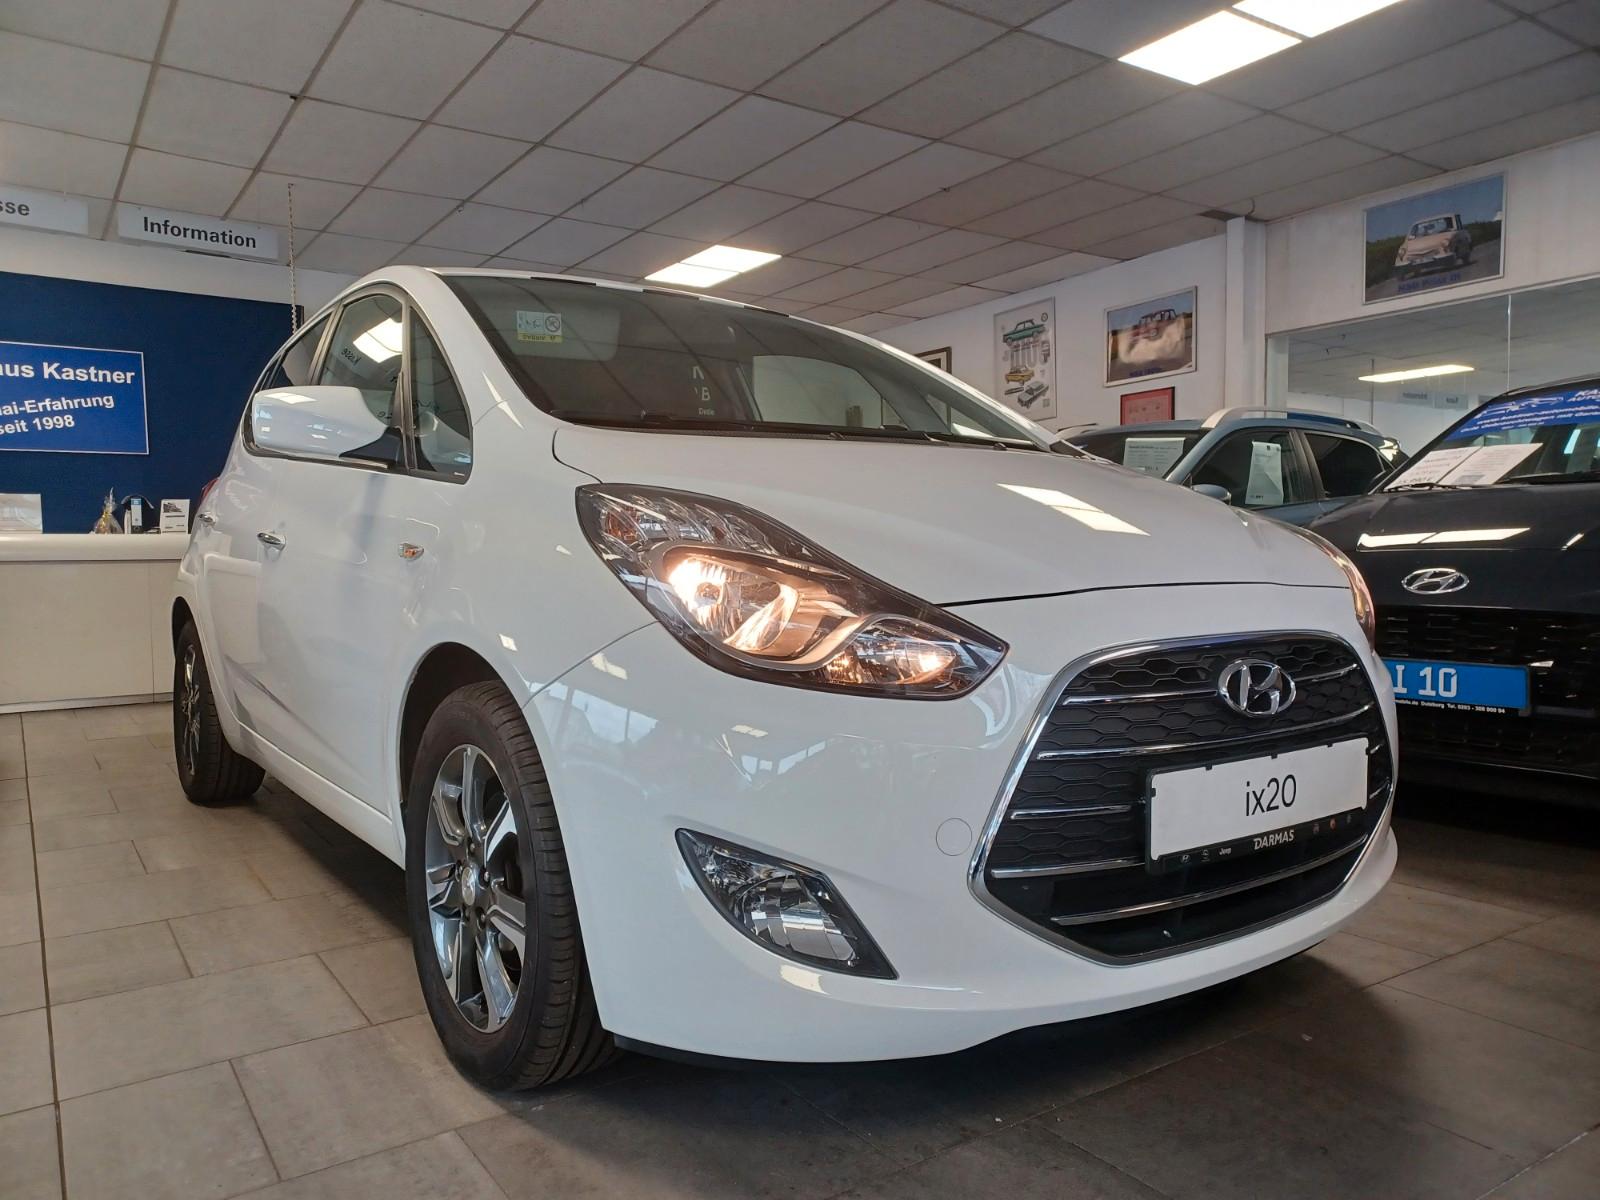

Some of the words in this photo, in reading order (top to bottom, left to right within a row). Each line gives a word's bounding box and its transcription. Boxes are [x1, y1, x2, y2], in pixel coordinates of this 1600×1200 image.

[143, 216, 256, 249] Information
[42, 361, 136, 384] Kastner
[0, 395, 115, 416] ai-Erfahrung
[32, 414, 75, 431] 1998
[1417, 666, 1458, 698] 10
[1245, 774, 1297, 817] ix20
[1253, 829, 1295, 850] DARMAS
